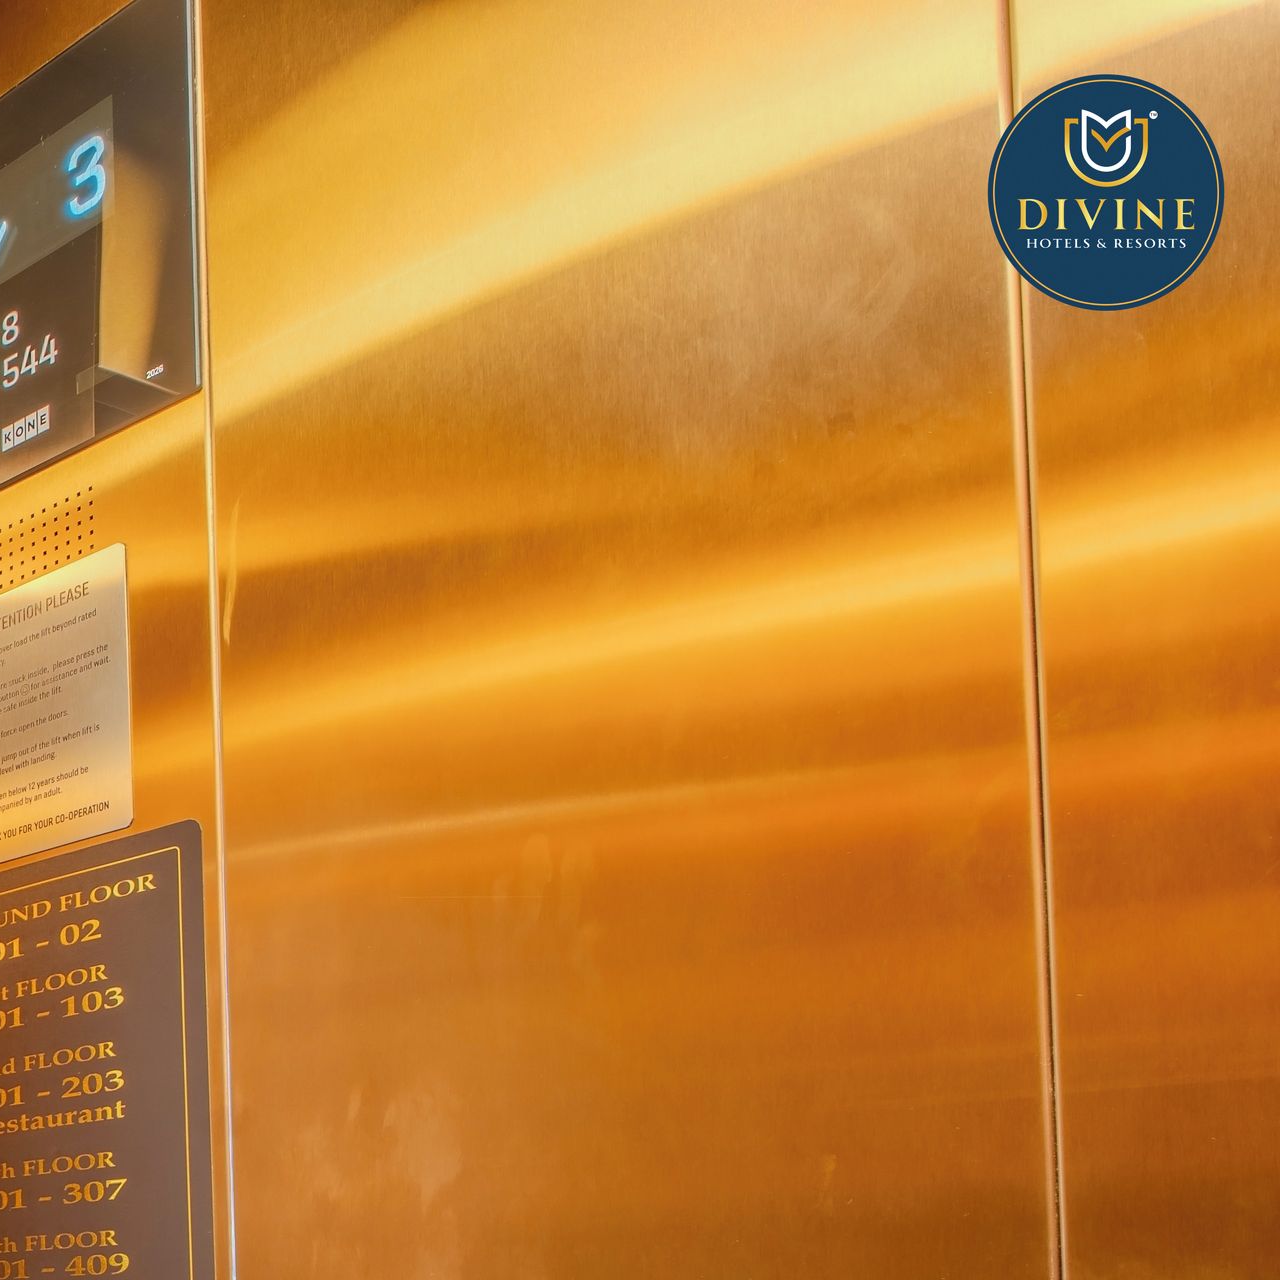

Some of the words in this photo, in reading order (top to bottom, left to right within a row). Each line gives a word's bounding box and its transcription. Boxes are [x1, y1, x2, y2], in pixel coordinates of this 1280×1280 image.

[67, 135, 106, 215] 3
[2, 310, 19, 346] 8
[2, 333, 58, 388] 544
[3, 413, 47, 444] KONE
[45, 581, 90, 612] PLEASE
[0, 643, 13, 654] over
[13, 636, 28, 648] load
[29, 632, 40, 642] the
[41, 626, 51, 637] lift
[52, 616, 77, 631] beyond
[77, 608, 97, 621] rated
[8, 674, 25, 686] stuck
[52, 656, 75, 672] please
[76, 648, 95, 663] press
[96, 643, 108, 654] the
[30, 682, 40, 691] for
[41, 668, 78, 687] assistance
[79, 662, 93, 673] and
[93, 655, 111, 667] wait.
[3, 702, 17, 713] safe
[18, 695, 37, 707] inside
[39, 691, 50, 700] the
[0, 727, 17, 738] force
[18, 722, 35, 733] open
[35, 717, 47, 726] the
[1, 752, 18, 765] jump
[18, 747, 29, 757] out
[30, 743, 38, 753] of
[38, 740, 50, 750] the
[51, 735, 61, 745] lift
[62, 730, 81, 742] when
[81, 725, 92, 736] lift
[93, 723, 100, 732] is
[0, 764, 15, 776] level
[15, 759, 30, 770] with
[8, 786, 27, 797] below
[28, 781, 36, 790] 12
[36, 776, 56, 790] years
[56, 767, 79, 782] should
[80, 766, 89, 775] be
[24, 796, 33, 805] by
[33, 793, 43, 802] an
[3, 827, 17, 840] YOU
[18, 823, 33, 835] FOR
[33, 817, 54, 831] YOUR
[55, 800, 110, 825] CO-OPERATION
[59, 873, 157, 913] FLOOR
[59, 918, 102, 946] 02
[16, 964, 108, 999] FLOOR
[60, 986, 125, 1018] 103
[23, 1041, 117, 1072] FLOOR
[61, 1069, 125, 1099] 203
[23, 1151, 116, 1177] FLOOR
[62, 1178, 128, 1205] 307
[25, 1230, 119, 1252] FLOOR
[64, 1253, 130, 1277] 409
